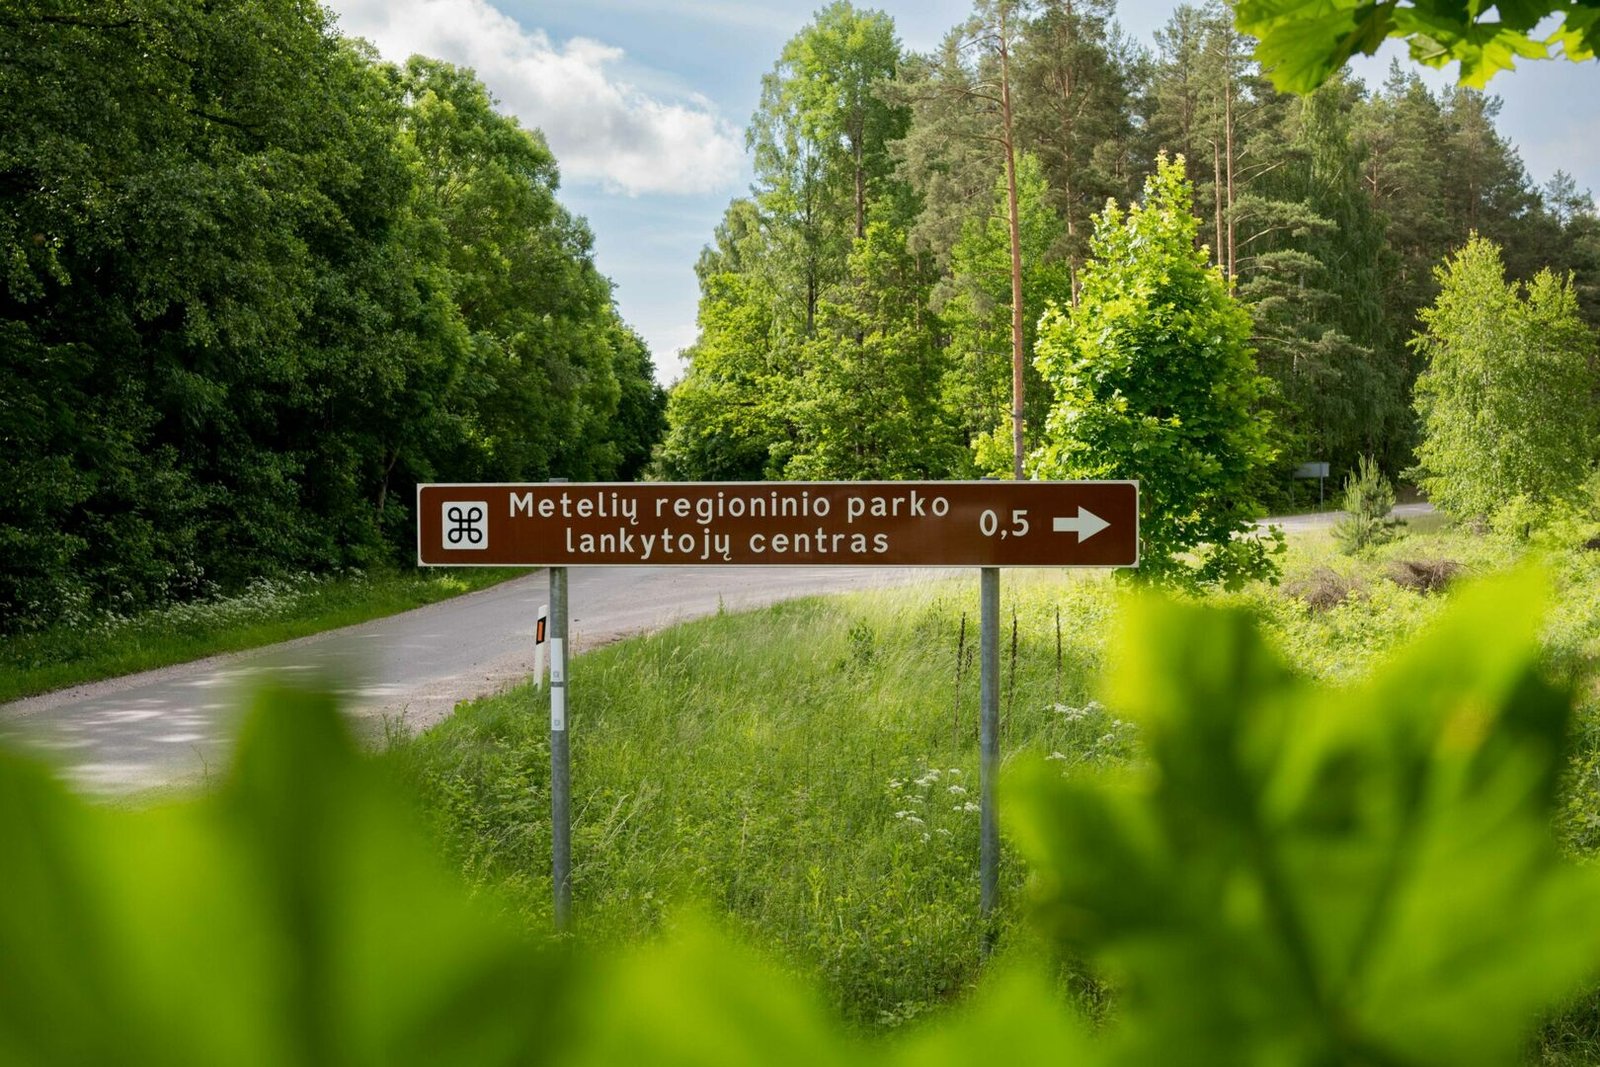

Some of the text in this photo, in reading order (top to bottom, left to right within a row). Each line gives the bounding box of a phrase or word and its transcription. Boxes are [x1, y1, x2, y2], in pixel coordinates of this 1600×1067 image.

[508, 490, 950, 525] Metelių regioninio parko
[979, 508, 1030, 540] 0,5
[566, 526, 889, 562] lankytojų centras
